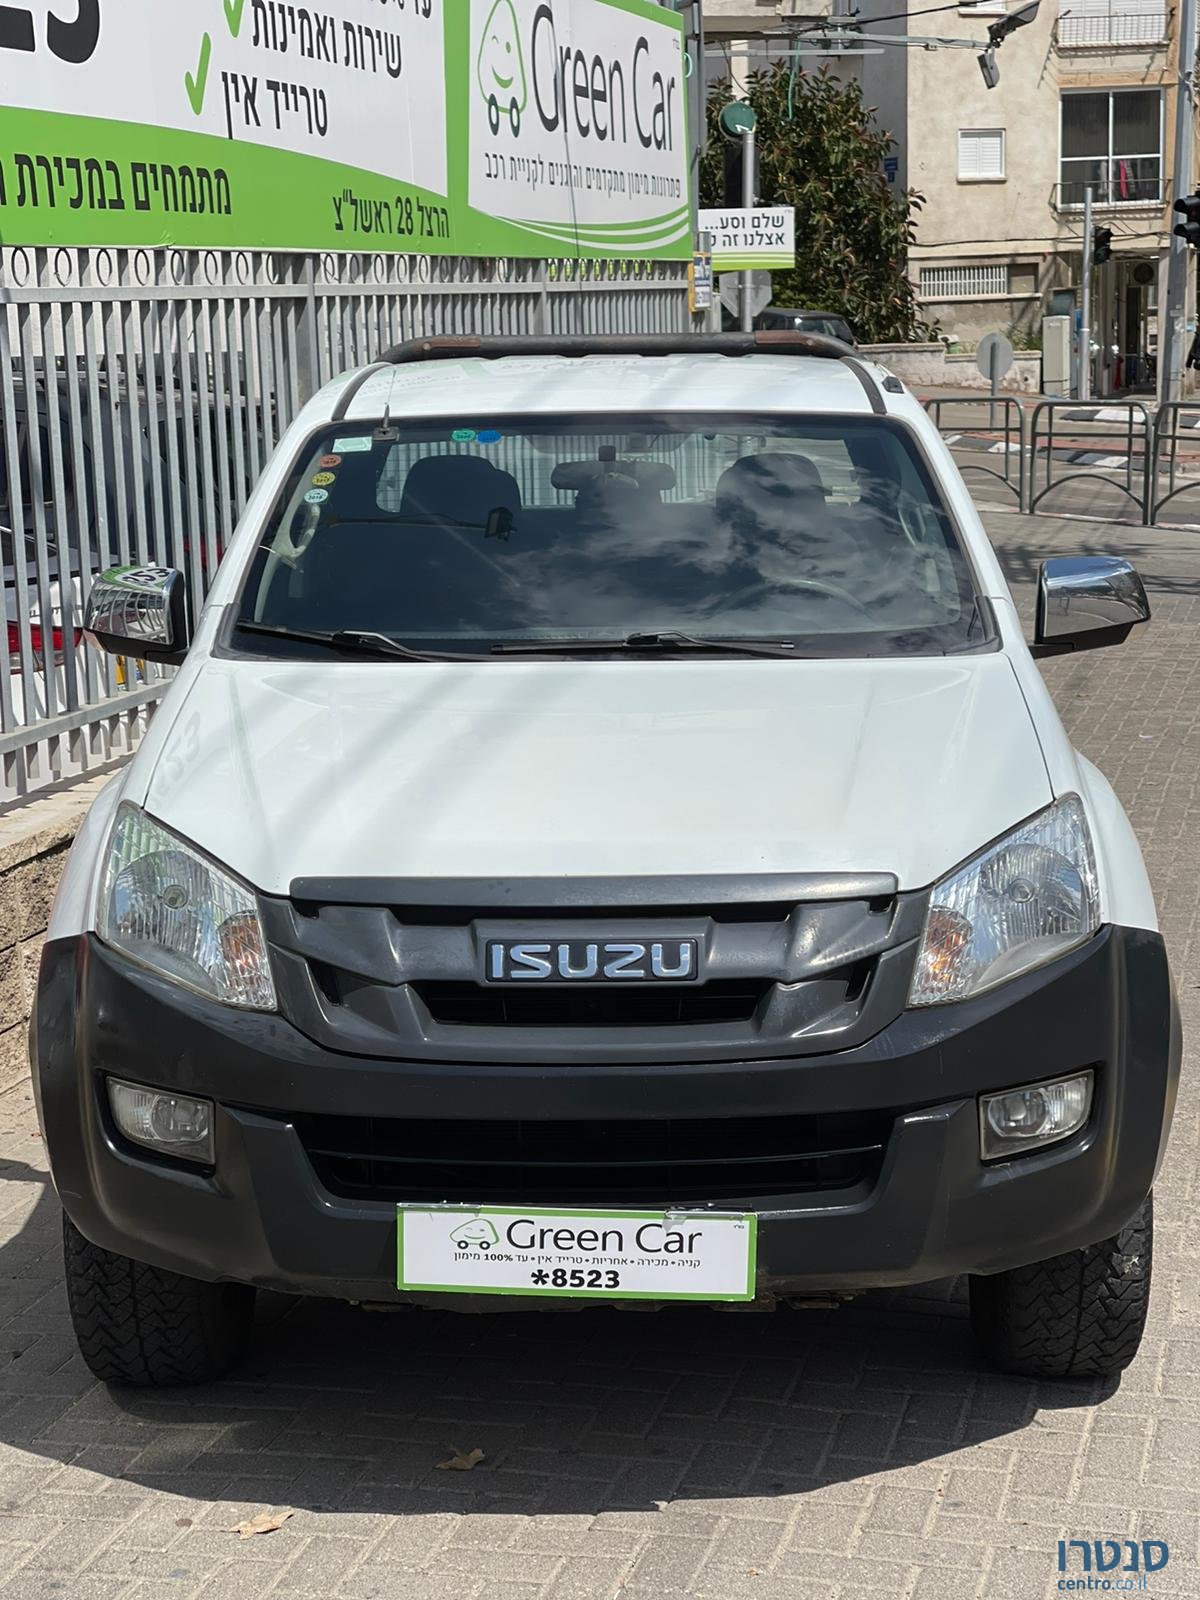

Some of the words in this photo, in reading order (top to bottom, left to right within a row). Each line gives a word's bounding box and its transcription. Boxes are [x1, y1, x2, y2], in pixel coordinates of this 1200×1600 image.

[251, 0, 338, 63] ואמינות
[343, 20, 401, 78] שירות
[531, 4, 627, 143] Green
[632, 36, 676, 151] Car
[221, 71, 262, 140] אין
[266, 79, 328, 136] טרייד
[484, 152, 506, 180] רכב
[509, 153, 544, 191] לקניית
[14, 153, 125, 209] במכירת
[131, 162, 231, 214] מתמחים
[585, 166, 625, 199] מתקדמים
[628, 171, 649, 200] מימון
[651, 174, 681, 198] פתרונות
[395, 195, 414, 236] 28
[416, 196, 449, 238] הרצל
[704, 216, 746, 230] וסע...
[751, 212, 785, 229] שלם
[722, 234, 740, 247] זה
[743, 230, 785, 246] אצלנו
[491, 943, 692, 979] ISUZU
[506, 1219, 624, 1252] Green
[635, 1223, 703, 1254] Car
[454, 1252, 481, 1261] מימון
[484, 1253, 514, 1262] 100%
[515, 1254, 529, 1263] עד
[537, 1254, 553, 1265] אין
[555, 1255, 583, 1264] טרייד
[591, 1257, 629, 1266] אחריות
[637, 1258, 669, 1267] מכירה
[677, 1259, 701, 1269] קניה
